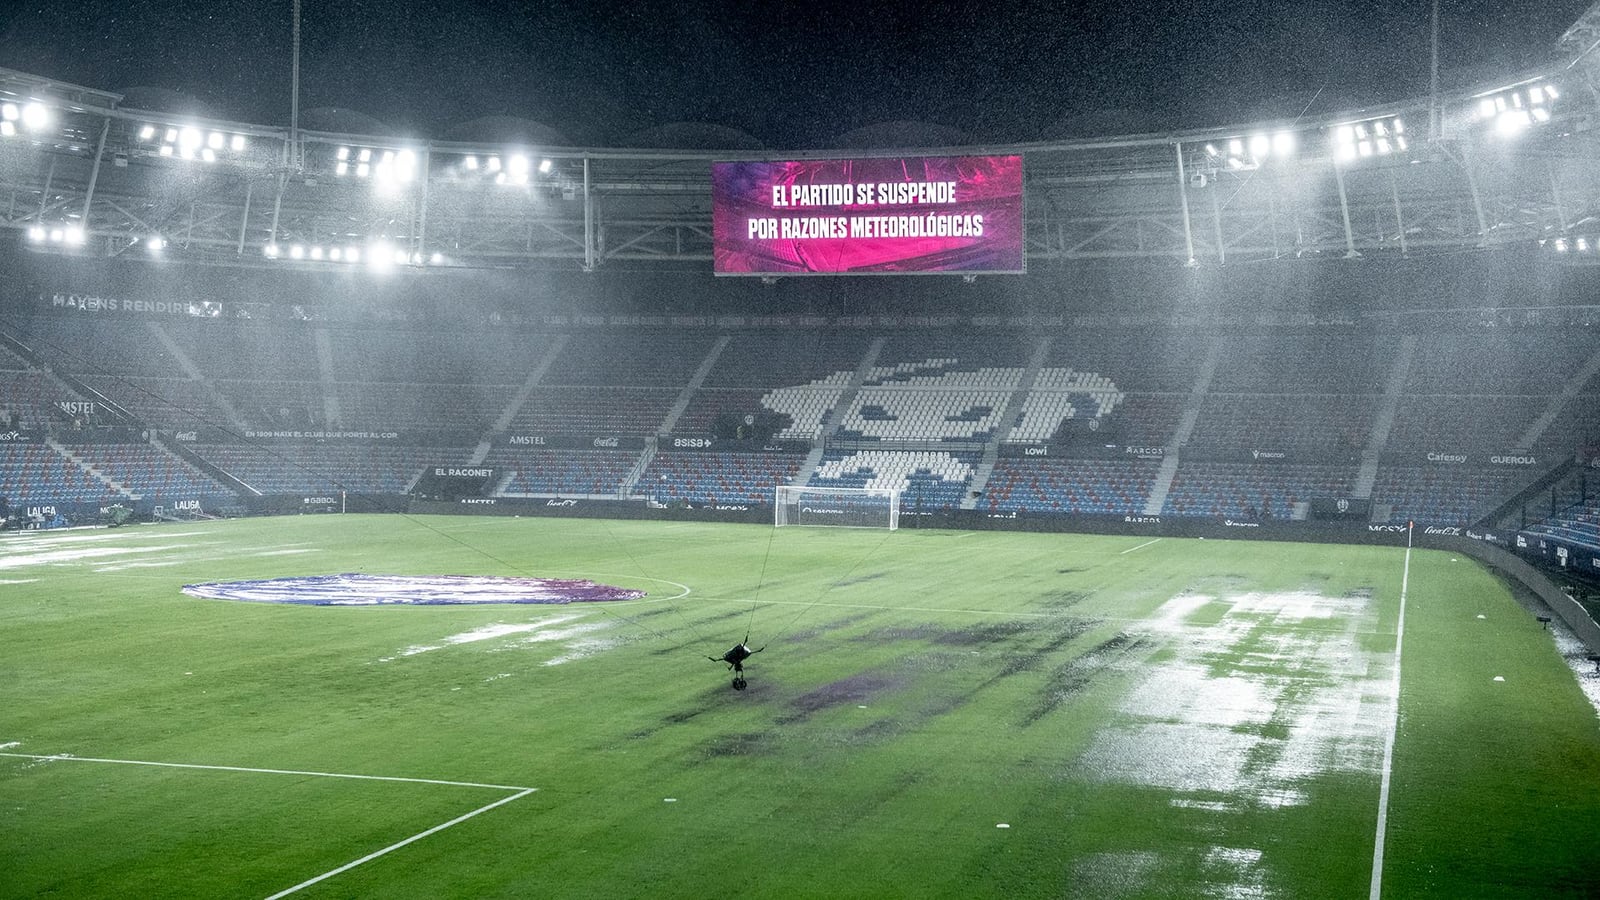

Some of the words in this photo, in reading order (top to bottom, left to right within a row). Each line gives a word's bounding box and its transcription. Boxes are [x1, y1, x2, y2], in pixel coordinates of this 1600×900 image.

[772, 185, 788, 206] EL
[791, 184, 853, 206] PARTIDO
[857, 183, 875, 205] SE
[877, 181, 957, 205] SUSPENDE
[748, 217, 779, 239] POR
[781, 216, 848, 239] RAZONES
[850, 212, 984, 238] METEOROLÓGICAS
[343, 431, 369, 439] PORTE
[369, 431, 380, 439] AL
[509, 436, 546, 445] AMSTEL
[674, 438, 703, 448] asisa
[1427, 452, 1467, 464] Cafesoy
[1490, 456, 1536, 465] GUEROLA
[435, 468, 447, 476] EL
[448, 468, 493, 478] RACONET
[175, 500, 200, 510] LALIGA
